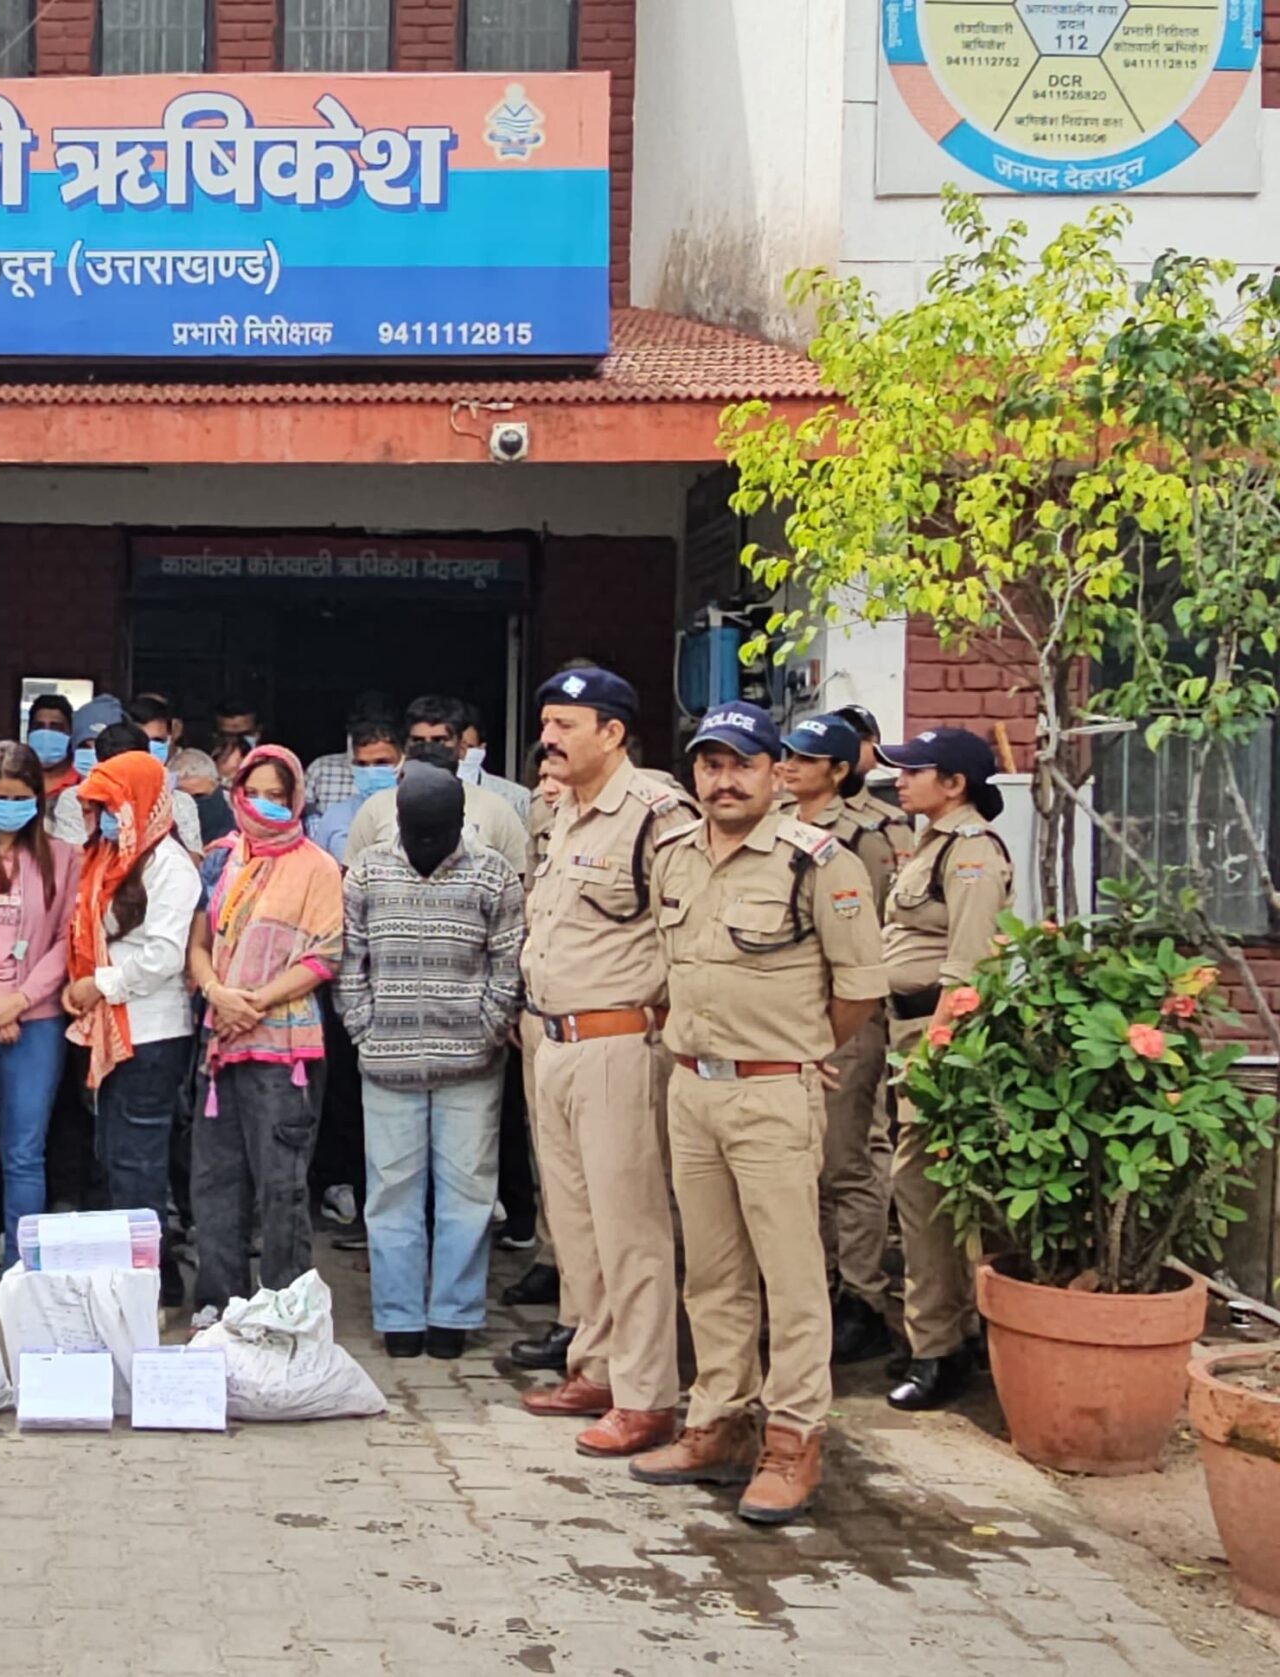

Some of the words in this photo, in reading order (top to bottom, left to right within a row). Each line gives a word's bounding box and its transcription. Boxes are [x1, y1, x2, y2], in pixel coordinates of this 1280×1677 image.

[1055, 34, 1088, 49] 112
[946, 56, 1020, 67] 9411112752
[1048, 75, 1082, 88] DCR
[51, 91, 457, 213] ऋषिकेश
[994, 155, 1059, 188] जनपद
[1064, 157, 1145, 189] देहरादून
[68, 240, 281, 296] (उत्तराखण्ड)
[172, 314, 238, 346] प्रभारी
[243, 314, 333, 346] निरीक्षक
[378, 321, 532, 346] 9411112815
[160, 548, 241, 576] कार्यालय
[247, 548, 333, 577] कोतवाली
[423, 550, 500, 589] देहरादून
[701, 711, 756, 733] POLICE
